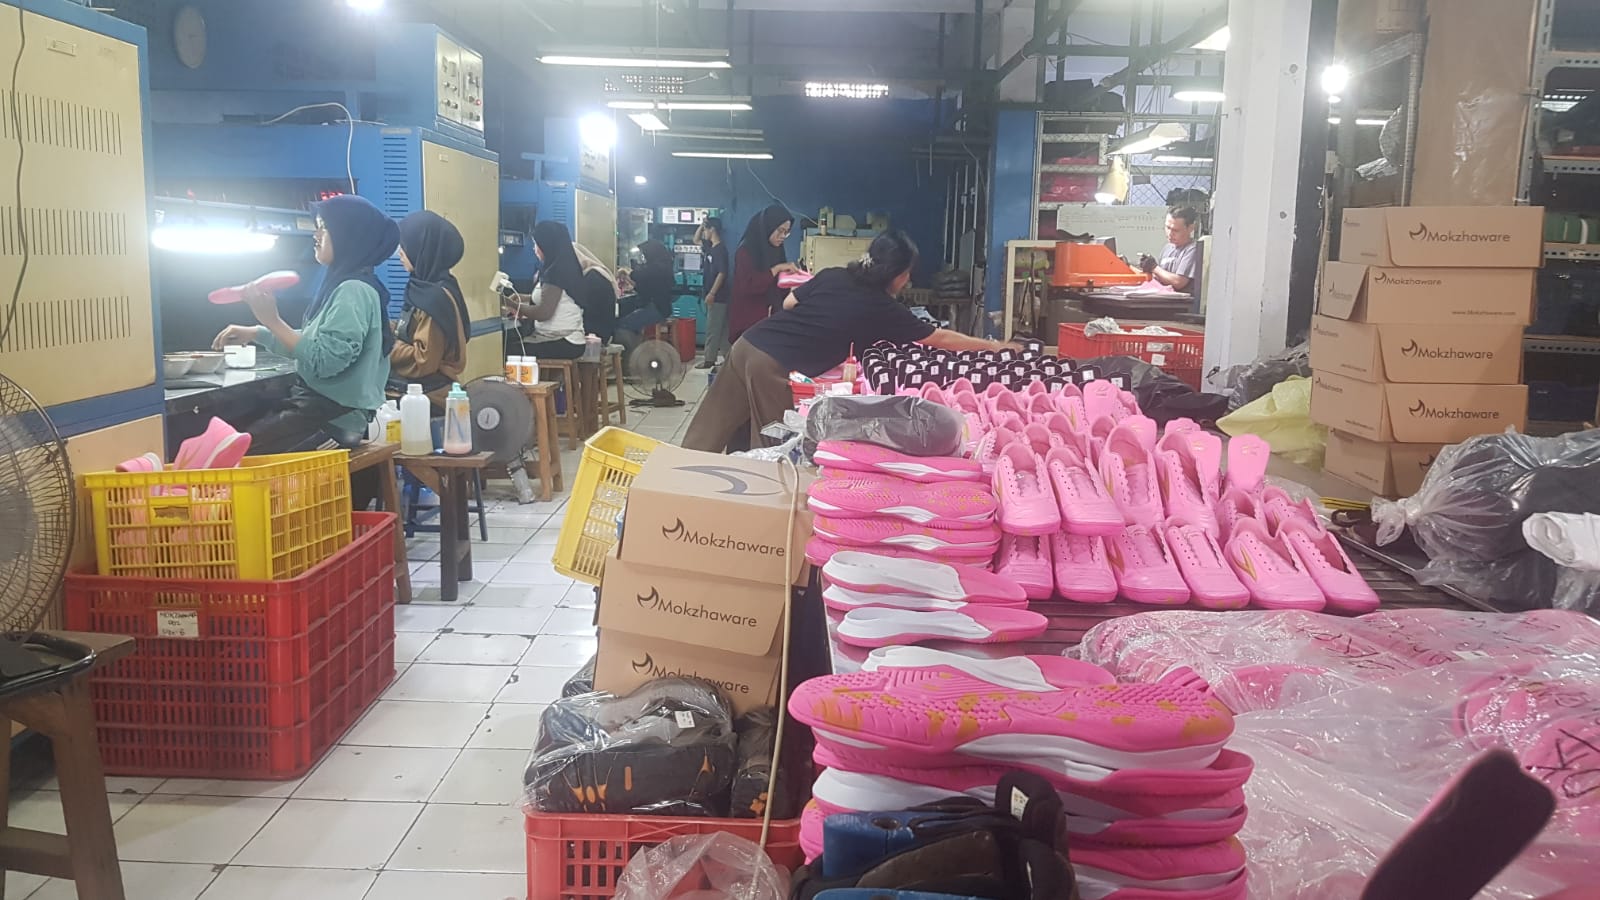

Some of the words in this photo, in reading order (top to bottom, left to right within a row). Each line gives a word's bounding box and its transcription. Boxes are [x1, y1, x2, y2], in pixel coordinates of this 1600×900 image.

[1426, 231, 1511, 243] Mokzhaware
[1386, 277, 1442, 286] Mokzhaware
[1418, 346, 1494, 360] Mokzhaware
[1424, 407, 1500, 420] Mokzhaware
[683, 529, 785, 557] Mokzhaware
[657, 598, 758, 628] Mokzhaware
